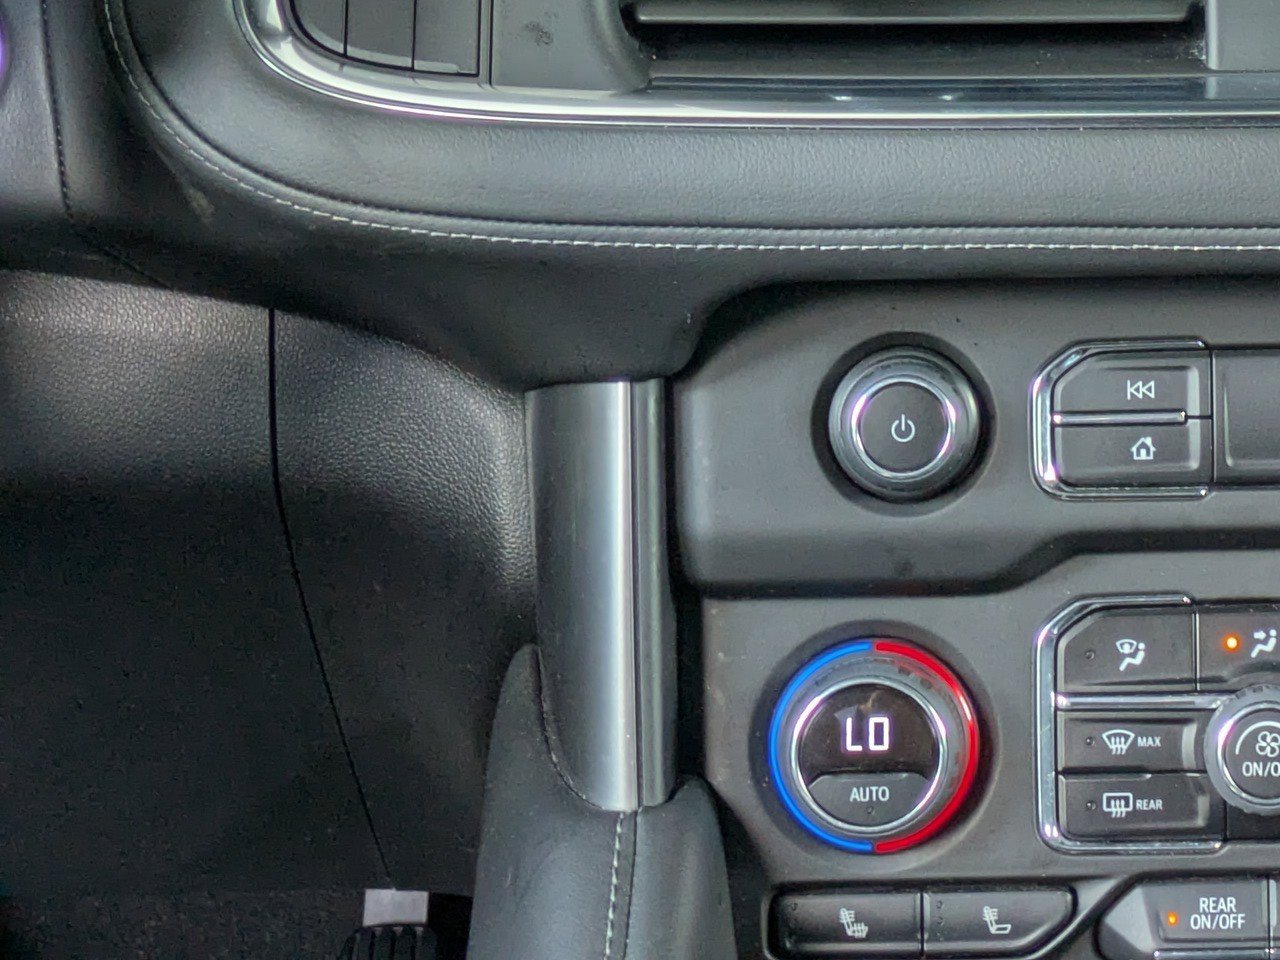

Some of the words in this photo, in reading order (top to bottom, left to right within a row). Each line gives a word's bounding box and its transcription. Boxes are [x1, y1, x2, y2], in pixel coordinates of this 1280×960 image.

[845, 717, 889, 751] LO
[1137, 736, 1162, 748] MAX
[850, 786, 890, 802] AUTO
[1136, 798, 1163, 811] REAR
[1199, 897, 1236, 914] REAR
[1190, 913, 1246, 930] ON/OFF
